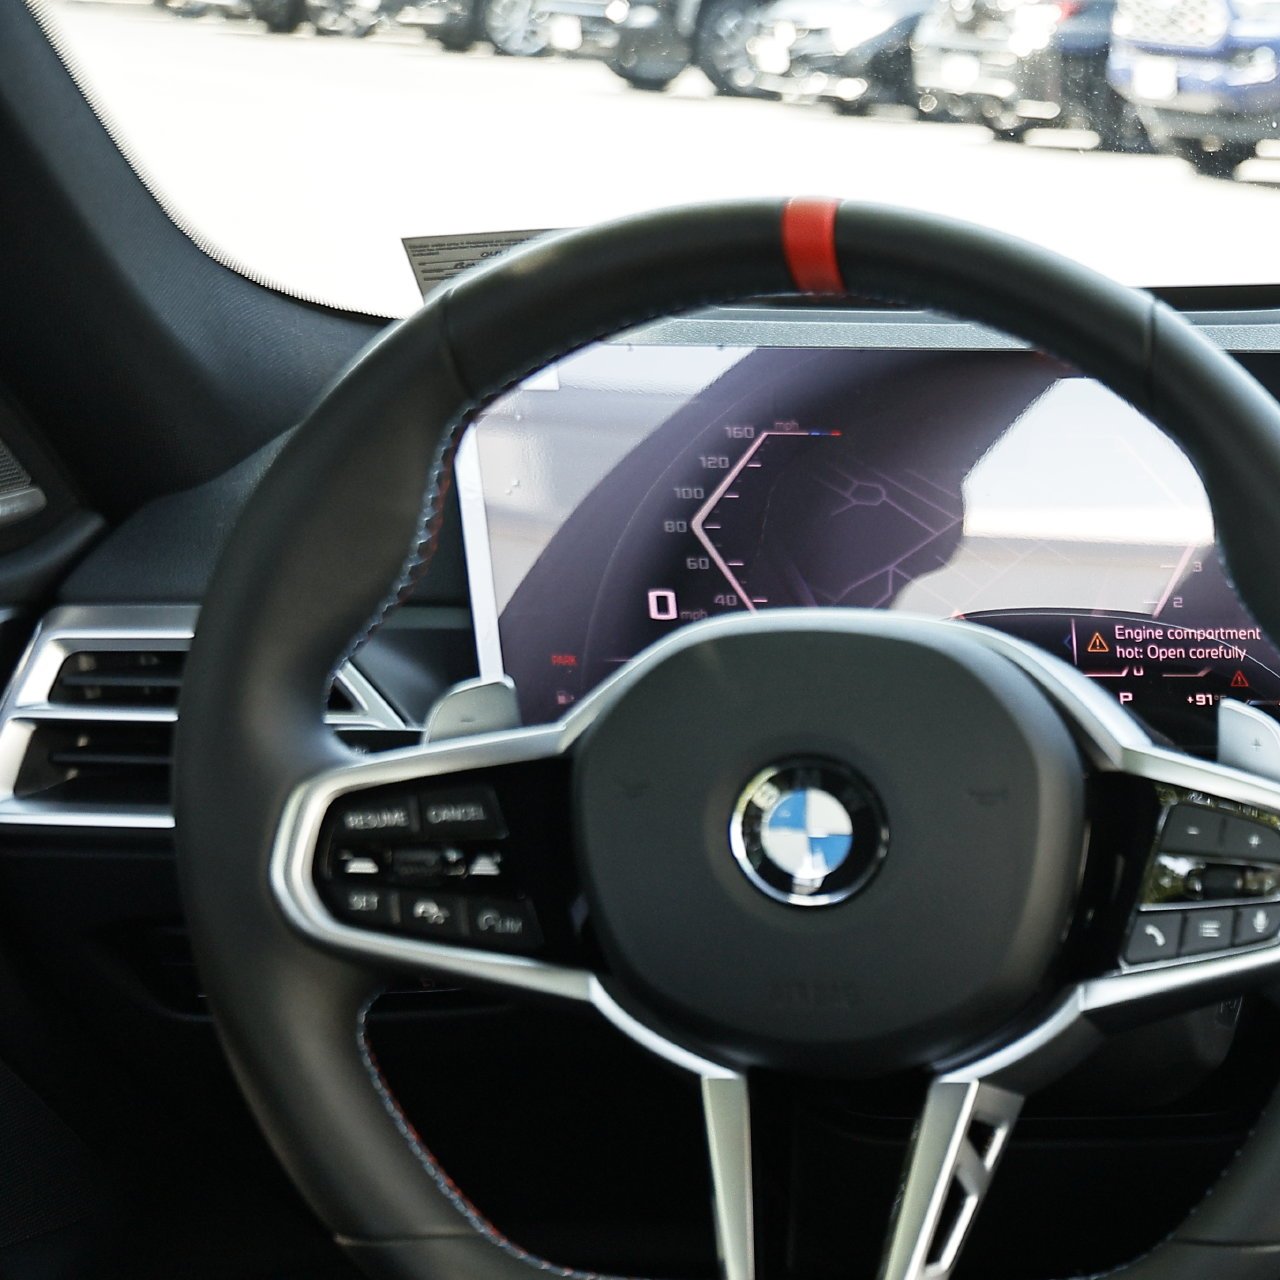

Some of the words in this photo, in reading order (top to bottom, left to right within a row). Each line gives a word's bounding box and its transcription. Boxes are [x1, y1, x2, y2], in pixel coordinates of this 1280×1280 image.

[775, 420, 799, 430] mph
[724, 426, 754, 439] 160
[699, 457, 729, 469] 120
[673, 488, 704, 499] 100
[664, 521, 687, 532] 80
[686, 558, 709, 570] 60
[1194, 562, 1202, 572] 3
[648, 590, 678, 620] 0
[680, 610, 708, 620] mph
[714, 595, 737, 606] 40
[1173, 598, 1183, 607] 2
[1114, 625, 1163, 644] Engine
[1167, 626, 1261, 642] compartment
[1116, 645, 1143, 659] hot:
[1147, 646, 1185, 661] Open
[1189, 645, 1246, 662] carefully
